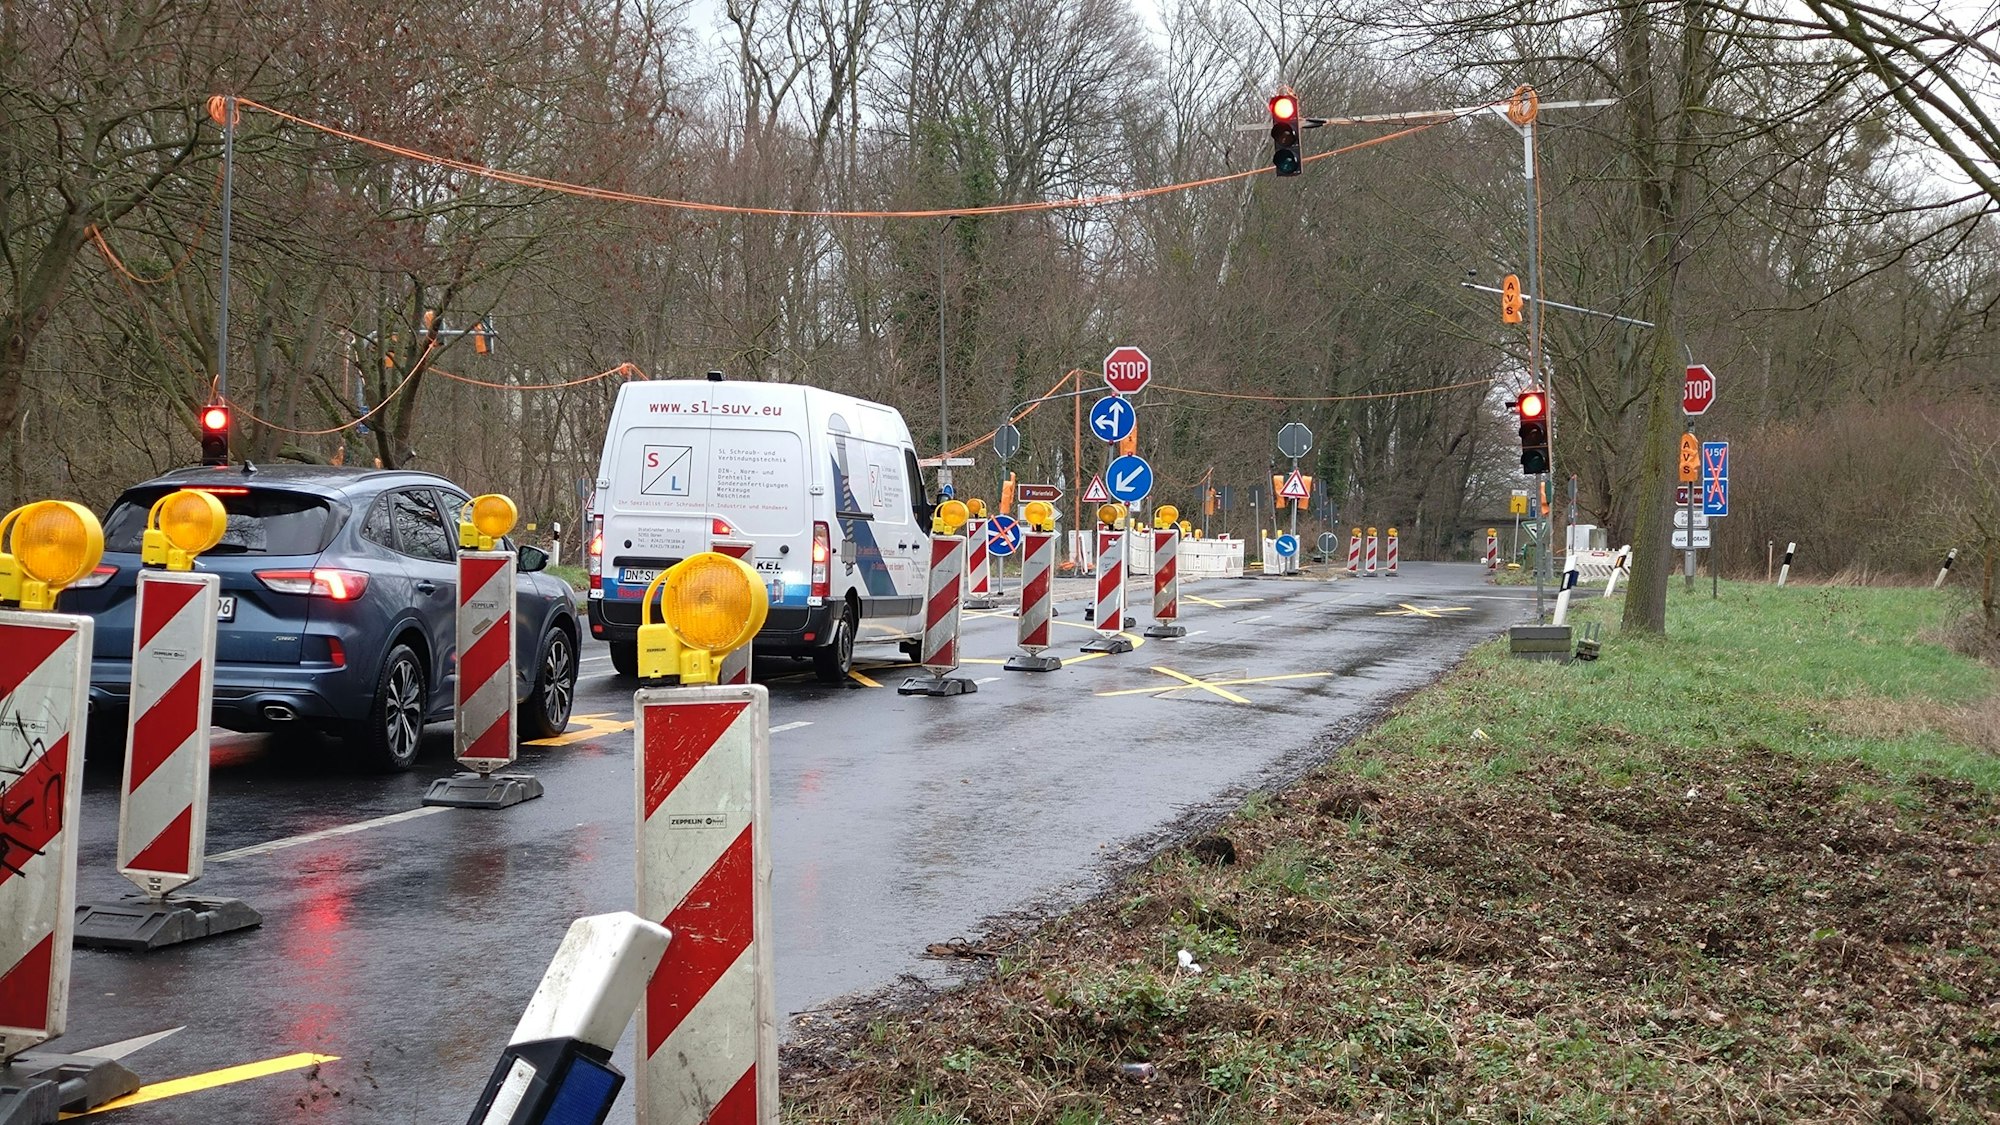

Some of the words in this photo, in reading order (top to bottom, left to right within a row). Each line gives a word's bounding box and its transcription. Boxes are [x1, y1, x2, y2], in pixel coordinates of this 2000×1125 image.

[1109, 361, 1146, 380] STOP
[1684, 380, 1711, 400] STOP
[649, 401, 782, 416] www.sl-suv.eu
[647, 452, 660, 468] S
[1683, 441, 1691, 474] AVS
[671, 476, 682, 491] L
[625, 570, 638, 580] DN
[644, 571, 654, 581] SL
